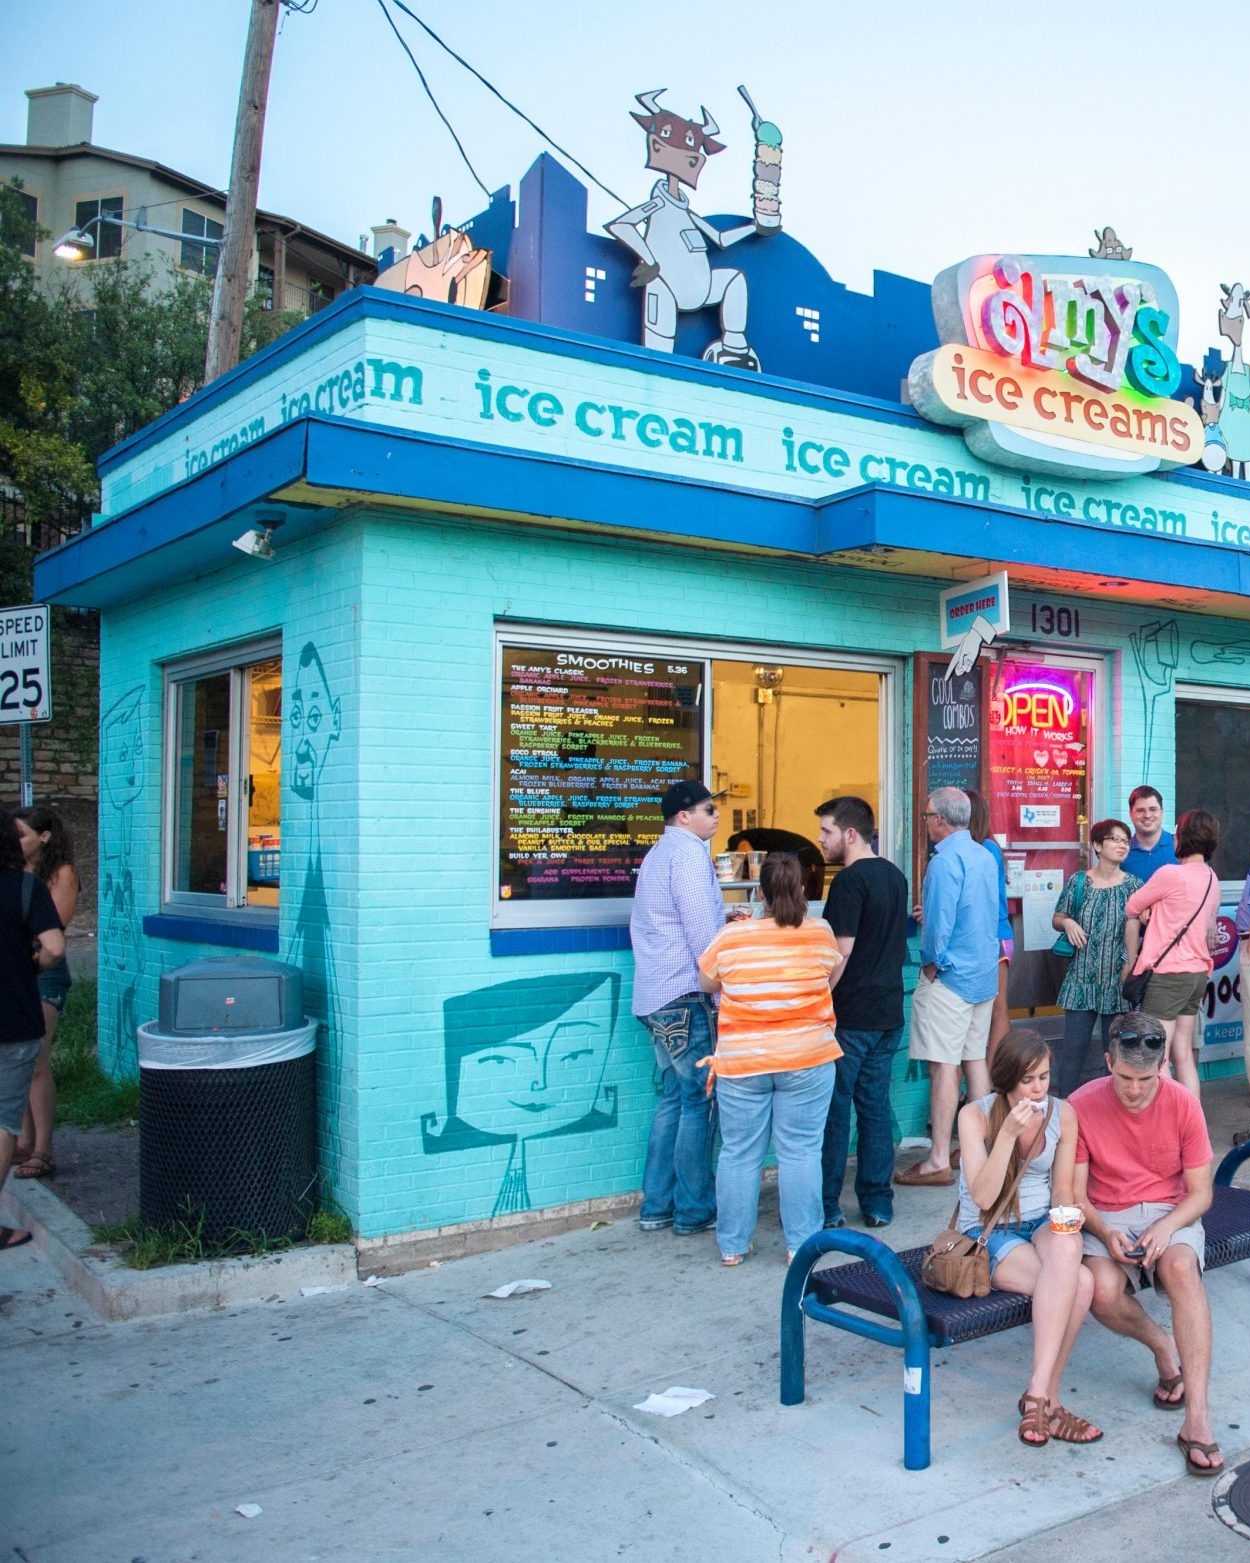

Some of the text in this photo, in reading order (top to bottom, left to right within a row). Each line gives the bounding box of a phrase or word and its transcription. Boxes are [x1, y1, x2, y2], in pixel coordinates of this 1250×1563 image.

[280, 359, 422, 424] ice cream
[952, 354, 1191, 451] ice creams
[472, 368, 744, 463] ice cream
[781, 427, 991, 502] ice cream
[1020, 475, 1188, 536] ice cream
[950, 597, 996, 619] ORDER HERE
[1031, 603, 1080, 637] 1301
[0, 615, 43, 636] SPEED
[2, 639, 38, 658] LIMIT
[557, 654, 654, 674] SMOOTHIES
[0, 667, 42, 710] 25
[521, 717, 572, 725] STRAWBERRIES
[567, 707, 599, 715] PLEASER
[943, 704, 975, 730] COMBOS
[999, 692, 1069, 728] OPEN
[1005, 726, 1073, 741] HOW IT WORKS
